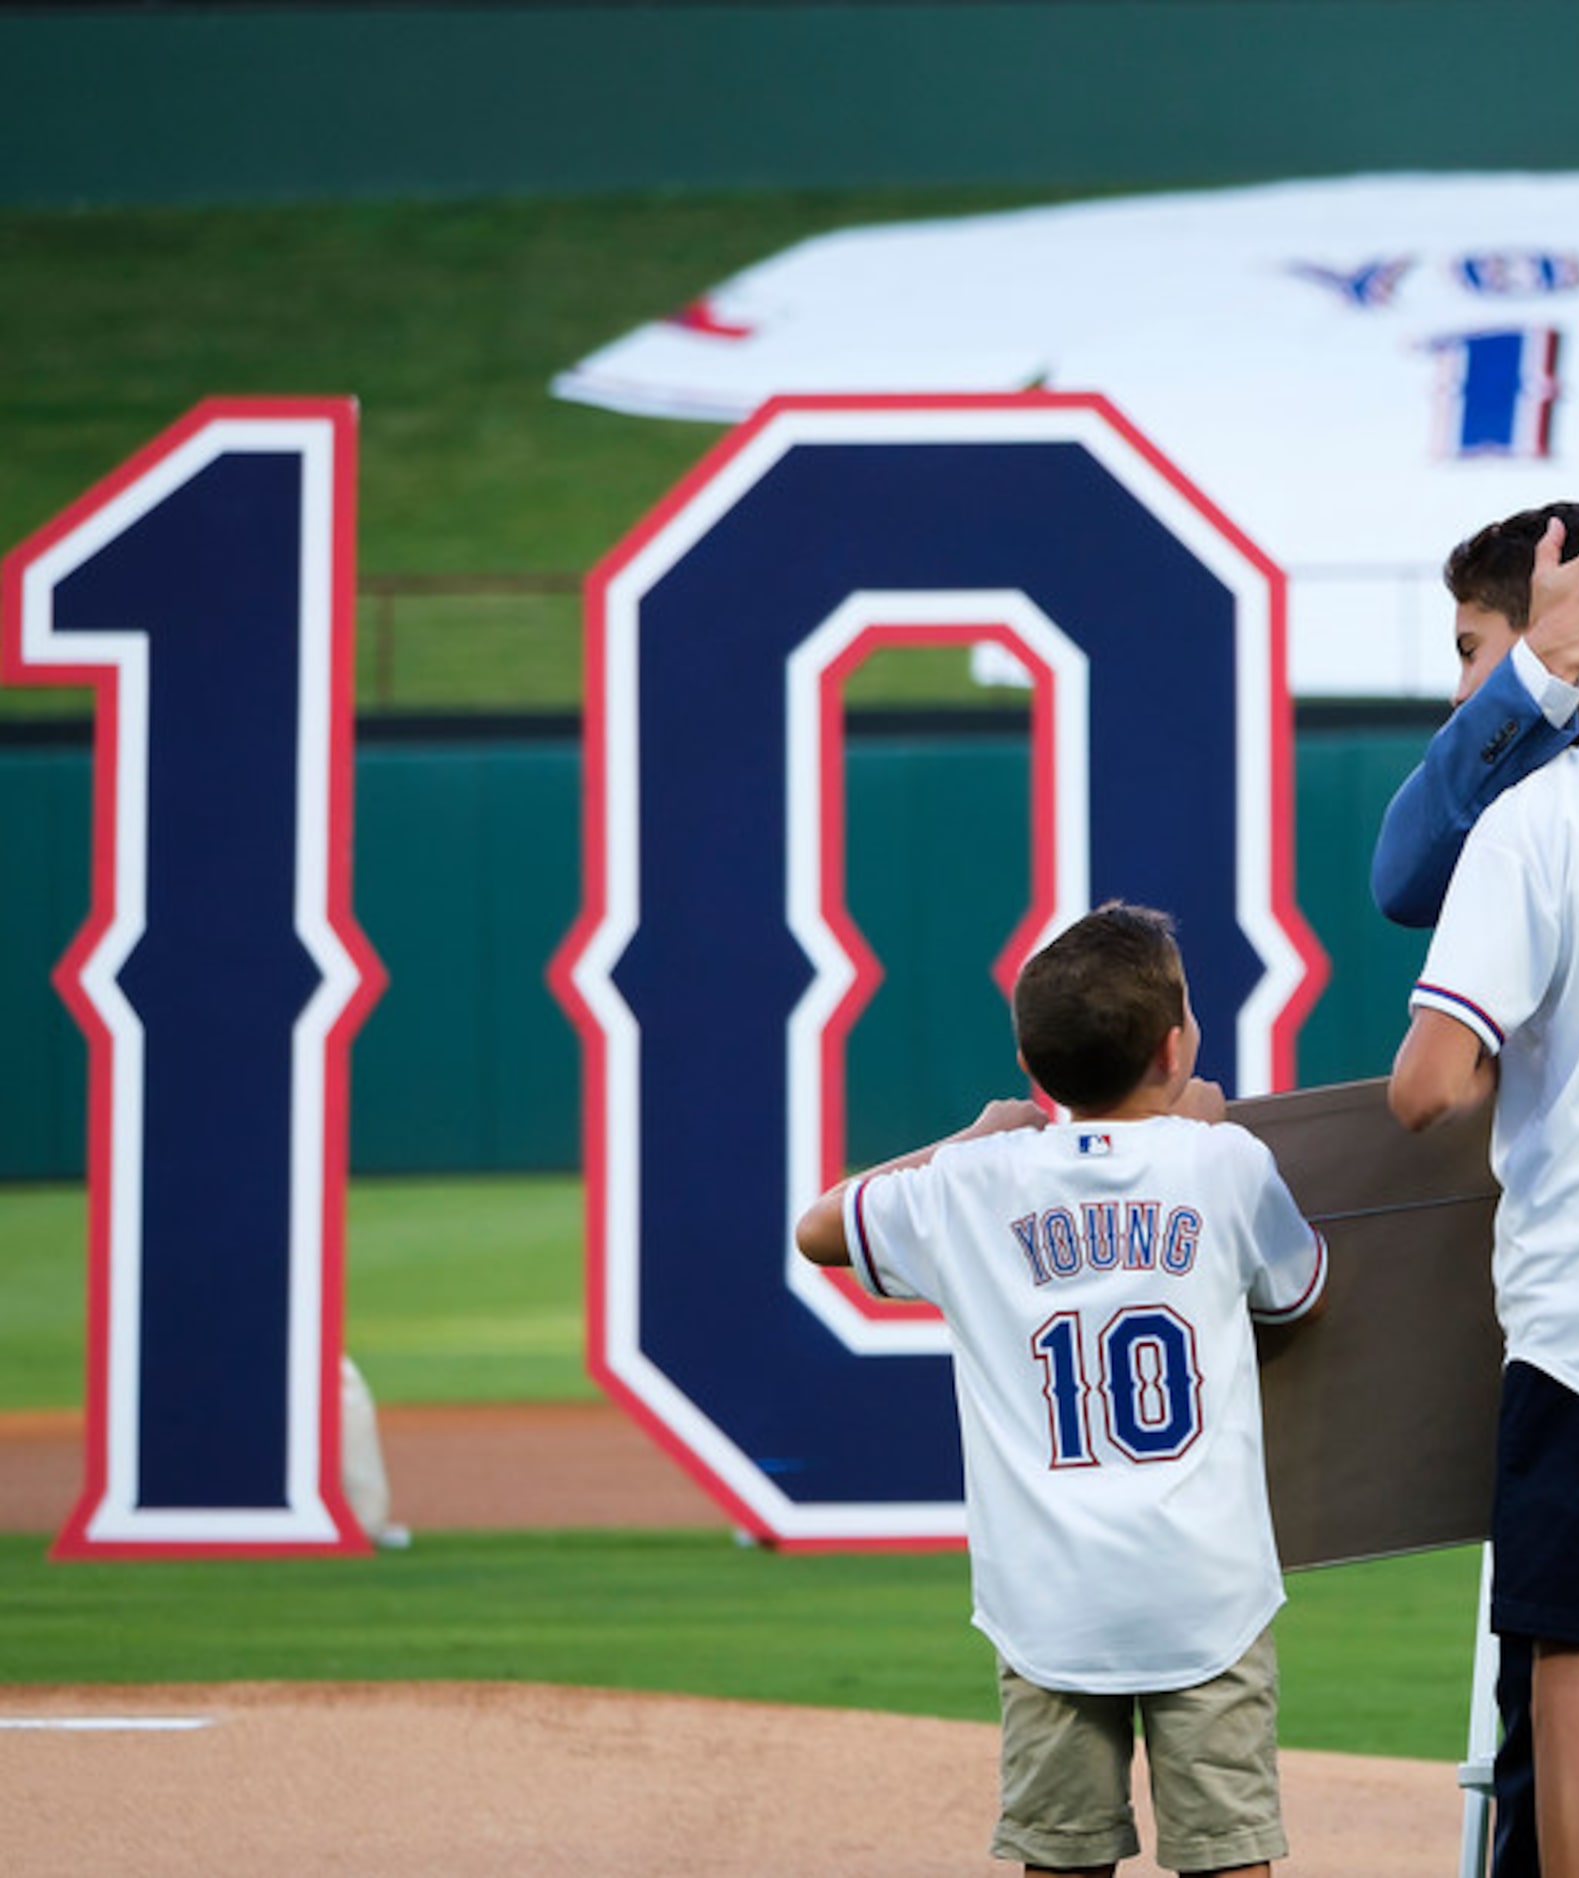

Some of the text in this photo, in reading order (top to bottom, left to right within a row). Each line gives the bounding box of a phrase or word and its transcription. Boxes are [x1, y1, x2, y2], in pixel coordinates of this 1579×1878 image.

[0, 392, 1332, 1558] 10
[1011, 1201, 1203, 1287] YOUNG
[1031, 1304, 1203, 1470] 10
